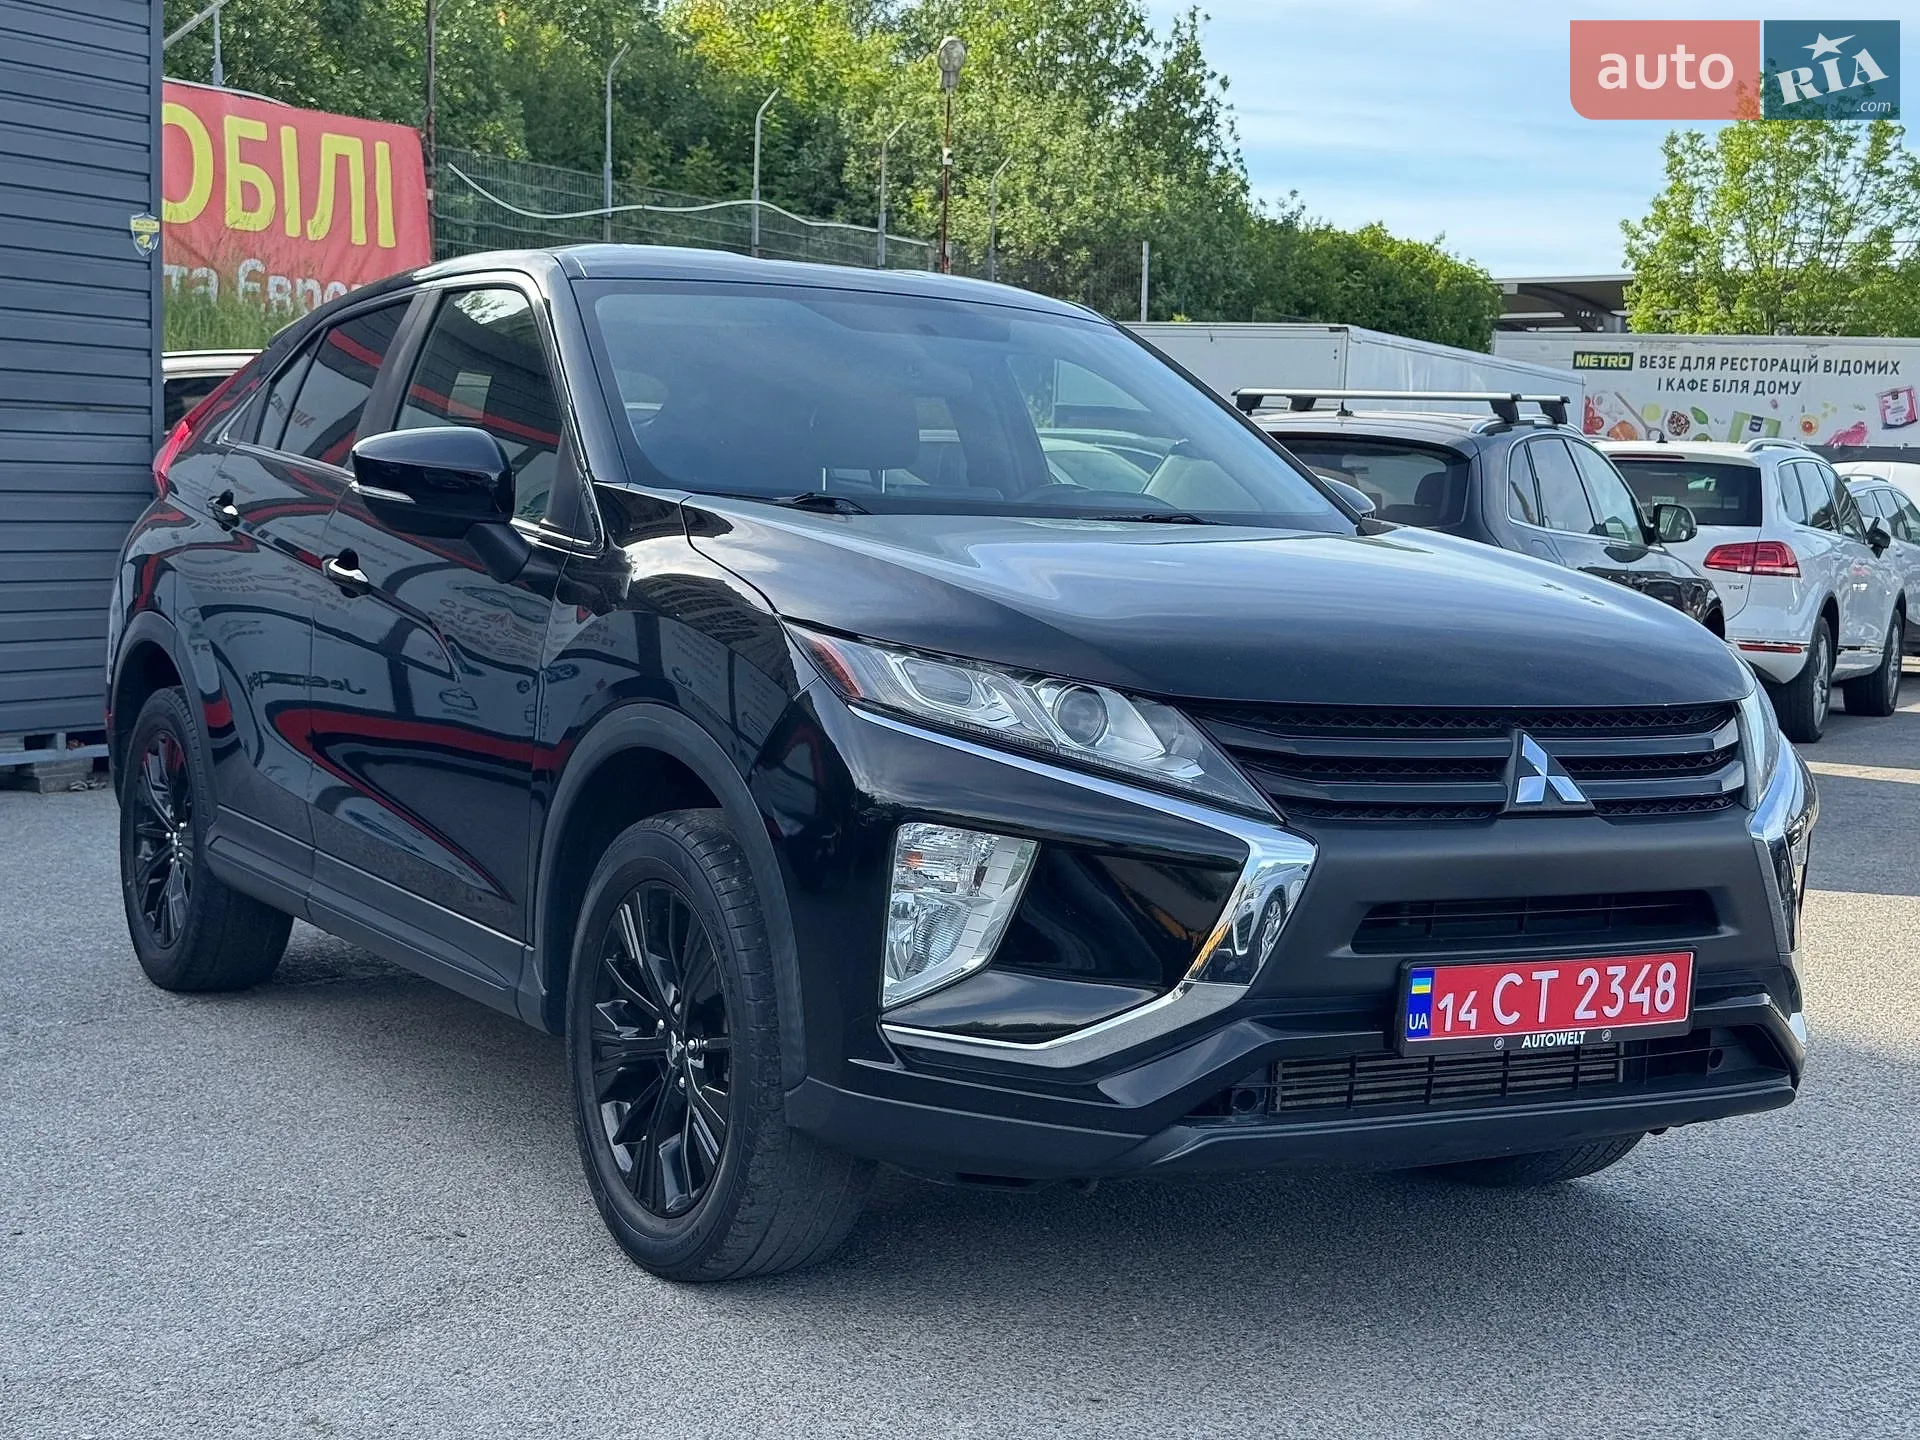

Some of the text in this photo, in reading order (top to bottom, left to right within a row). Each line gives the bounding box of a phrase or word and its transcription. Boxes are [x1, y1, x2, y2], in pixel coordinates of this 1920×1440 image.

[1575, 354, 1631, 368] METRO
[1639, 354, 1901, 376] ВЕЗЕ ДЛЯ РЕСТОРАЦІЙ ВІДОМИХ
[1665, 378, 1707, 394] КАФЕ
[1712, 378, 1750, 394] БІЛЯ
[1753, 380, 1802, 396] ДОМУ
[1437, 962, 1677, 1031] 14 CT 2348
[1408, 1012, 1429, 1030] UA
[1521, 1031, 1586, 1048] AUTOWELT
